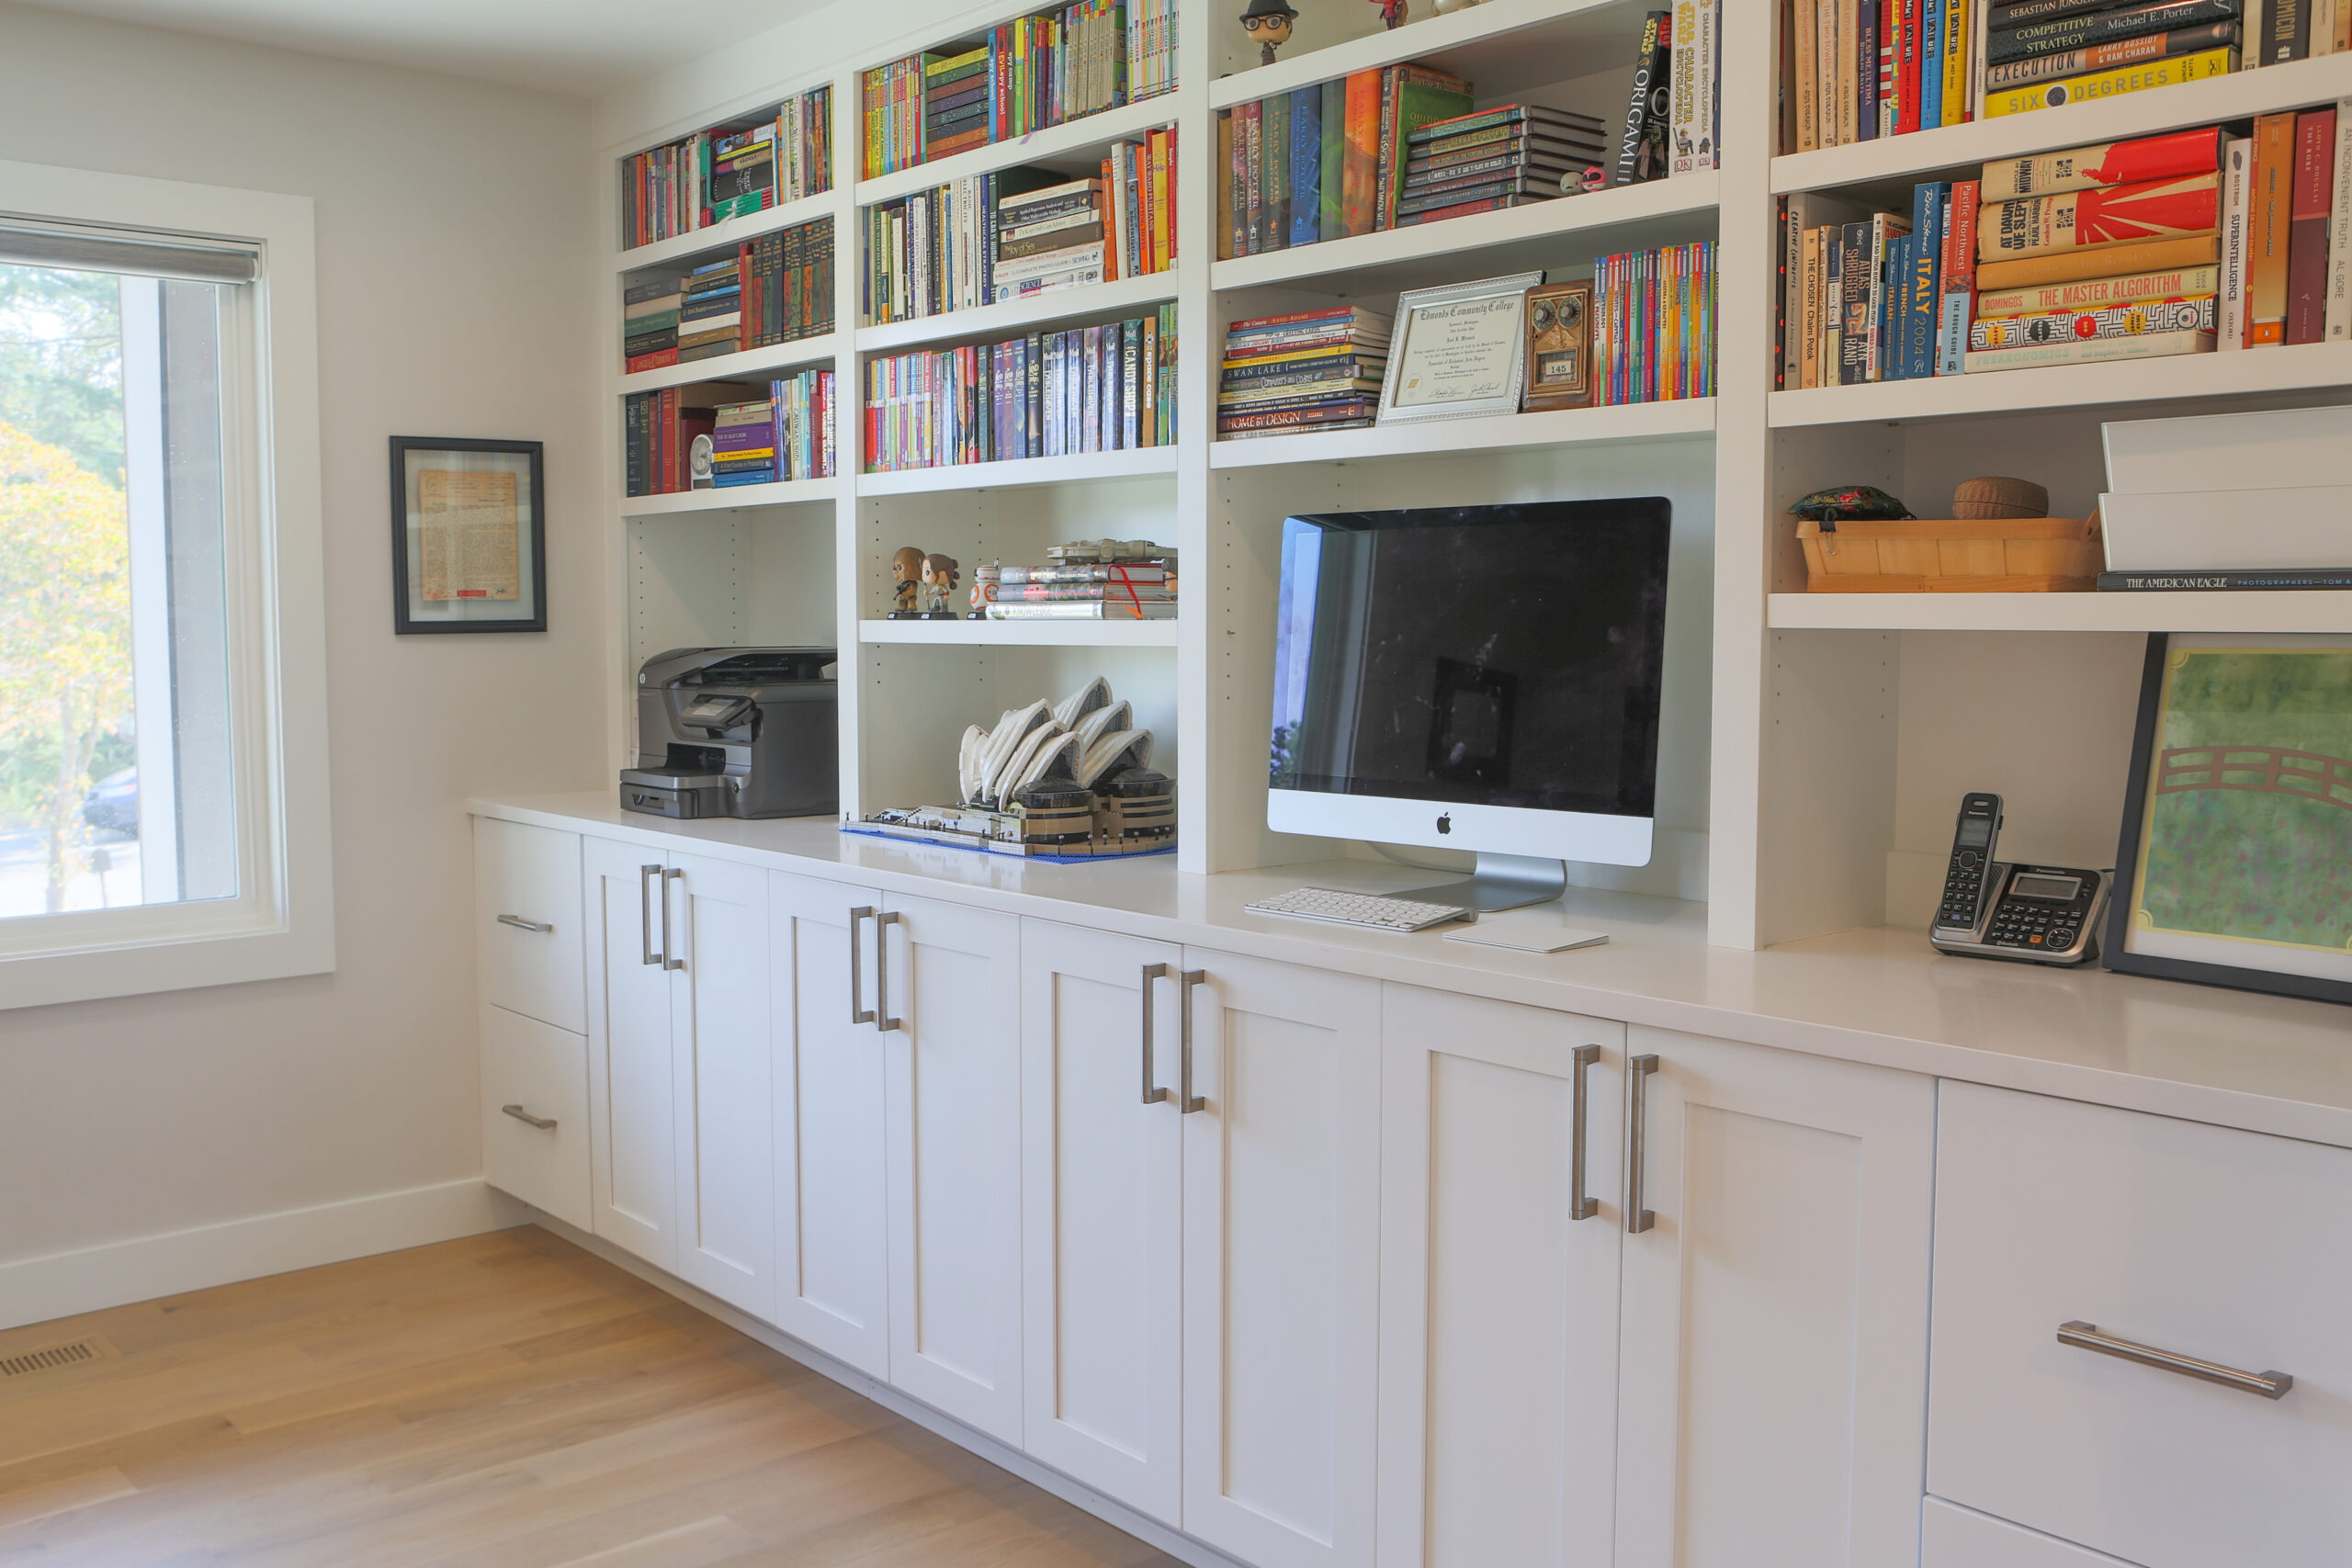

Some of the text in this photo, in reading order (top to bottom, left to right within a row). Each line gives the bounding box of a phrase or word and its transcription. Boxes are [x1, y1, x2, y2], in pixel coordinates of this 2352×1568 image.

[1678, 2, 1687, 45] WARS
[2009, 2, 2056, 18] SEBASTIAN
[2107, 6, 2194, 30] Michael E. Porter
[1640, 18, 1652, 54] WARS
[1648, 23, 1657, 53] STAR
[1686, 6, 1695, 45] STAR
[1927, 17, 1936, 60] FAILURE
[1949, 13, 1960, 55] FAILURE
[2016, 17, 2094, 40] COMPETITIVE
[1904, 23, 1913, 64] FAILURE
[2027, 32, 2086, 53] STRATEGY
[2098, 35, 2159, 54] LARRY BOSSIDY
[2106, 51, 2124, 62] RAM
[2125, 45, 2156, 59] CHARAN
[1994, 52, 2076, 83] EXECUTION
[1675, 49, 1685, 125] ENCYCLOPEDIA
[1684, 47, 1694, 124] CHARACTER
[2009, 69, 2168, 113] SIX DEGREES
[1621, 69, 1649, 167] ORIGAMI
[1676, 160, 1690, 170] DK
[2018, 160, 2032, 194] MIDWAY
[1377, 177, 1385, 209] ROWLING
[2000, 202, 2015, 249] AT DAWN
[2013, 199, 2029, 250] WE SLEPT
[2030, 197, 2041, 224] HARBOR
[2335, 129, 2352, 299] AN INCONVENIENT TRUTH AL GORE
[1791, 210, 1799, 246] CREATIVE
[1957, 185, 1972, 270] Pacific Northwest
[2031, 225, 2040, 246] PEARL
[1010, 245, 1018, 255] Joy
[1026, 242, 1035, 250] Sex
[1072, 256, 1090, 265] SEWING
[2228, 214, 2240, 301] SUPERINTELLIGENCE
[1020, 278, 1042, 290] SCIENCE
[1845, 248, 1859, 302] SHRUGGED
[1859, 259, 1871, 289] ATLAS
[1914, 188, 1933, 355] Rick ITALY 2004
[1807, 274, 1815, 307] CHOSEN
[1886, 287, 1895, 320] ITALIAN
[1900, 283, 1908, 317] FRENCH
[1984, 295, 2023, 311] DOMINGOS
[2038, 274, 2182, 307] THE MASTER ALGORITHM
[1419, 301, 1514, 321] Edmonds Community College
[1829, 303, 1838, 323] YOGA
[1951, 314, 1960, 334] ROUGH
[1806, 338, 1815, 360] Potok
[1844, 337, 1858, 366] RAND
[1857, 341, 1868, 361] AYN
[1976, 347, 2070, 366] FREAKONOMICS
[1125, 350, 1136, 410] CANDY SHOP
[1145, 352, 1153, 382] space
[1227, 365, 1281, 378] SWAN LAKE
[1261, 376, 1286, 389] Computers
[1295, 374, 1313, 384] Coding
[1551, 365, 1566, 374] 145
[1227, 415, 1256, 429] HOME
[1256, 416, 1265, 427] BY
[1266, 411, 1302, 425] DESIGN
[2126, 577, 2227, 588] THE AMERICAN EAGLE
